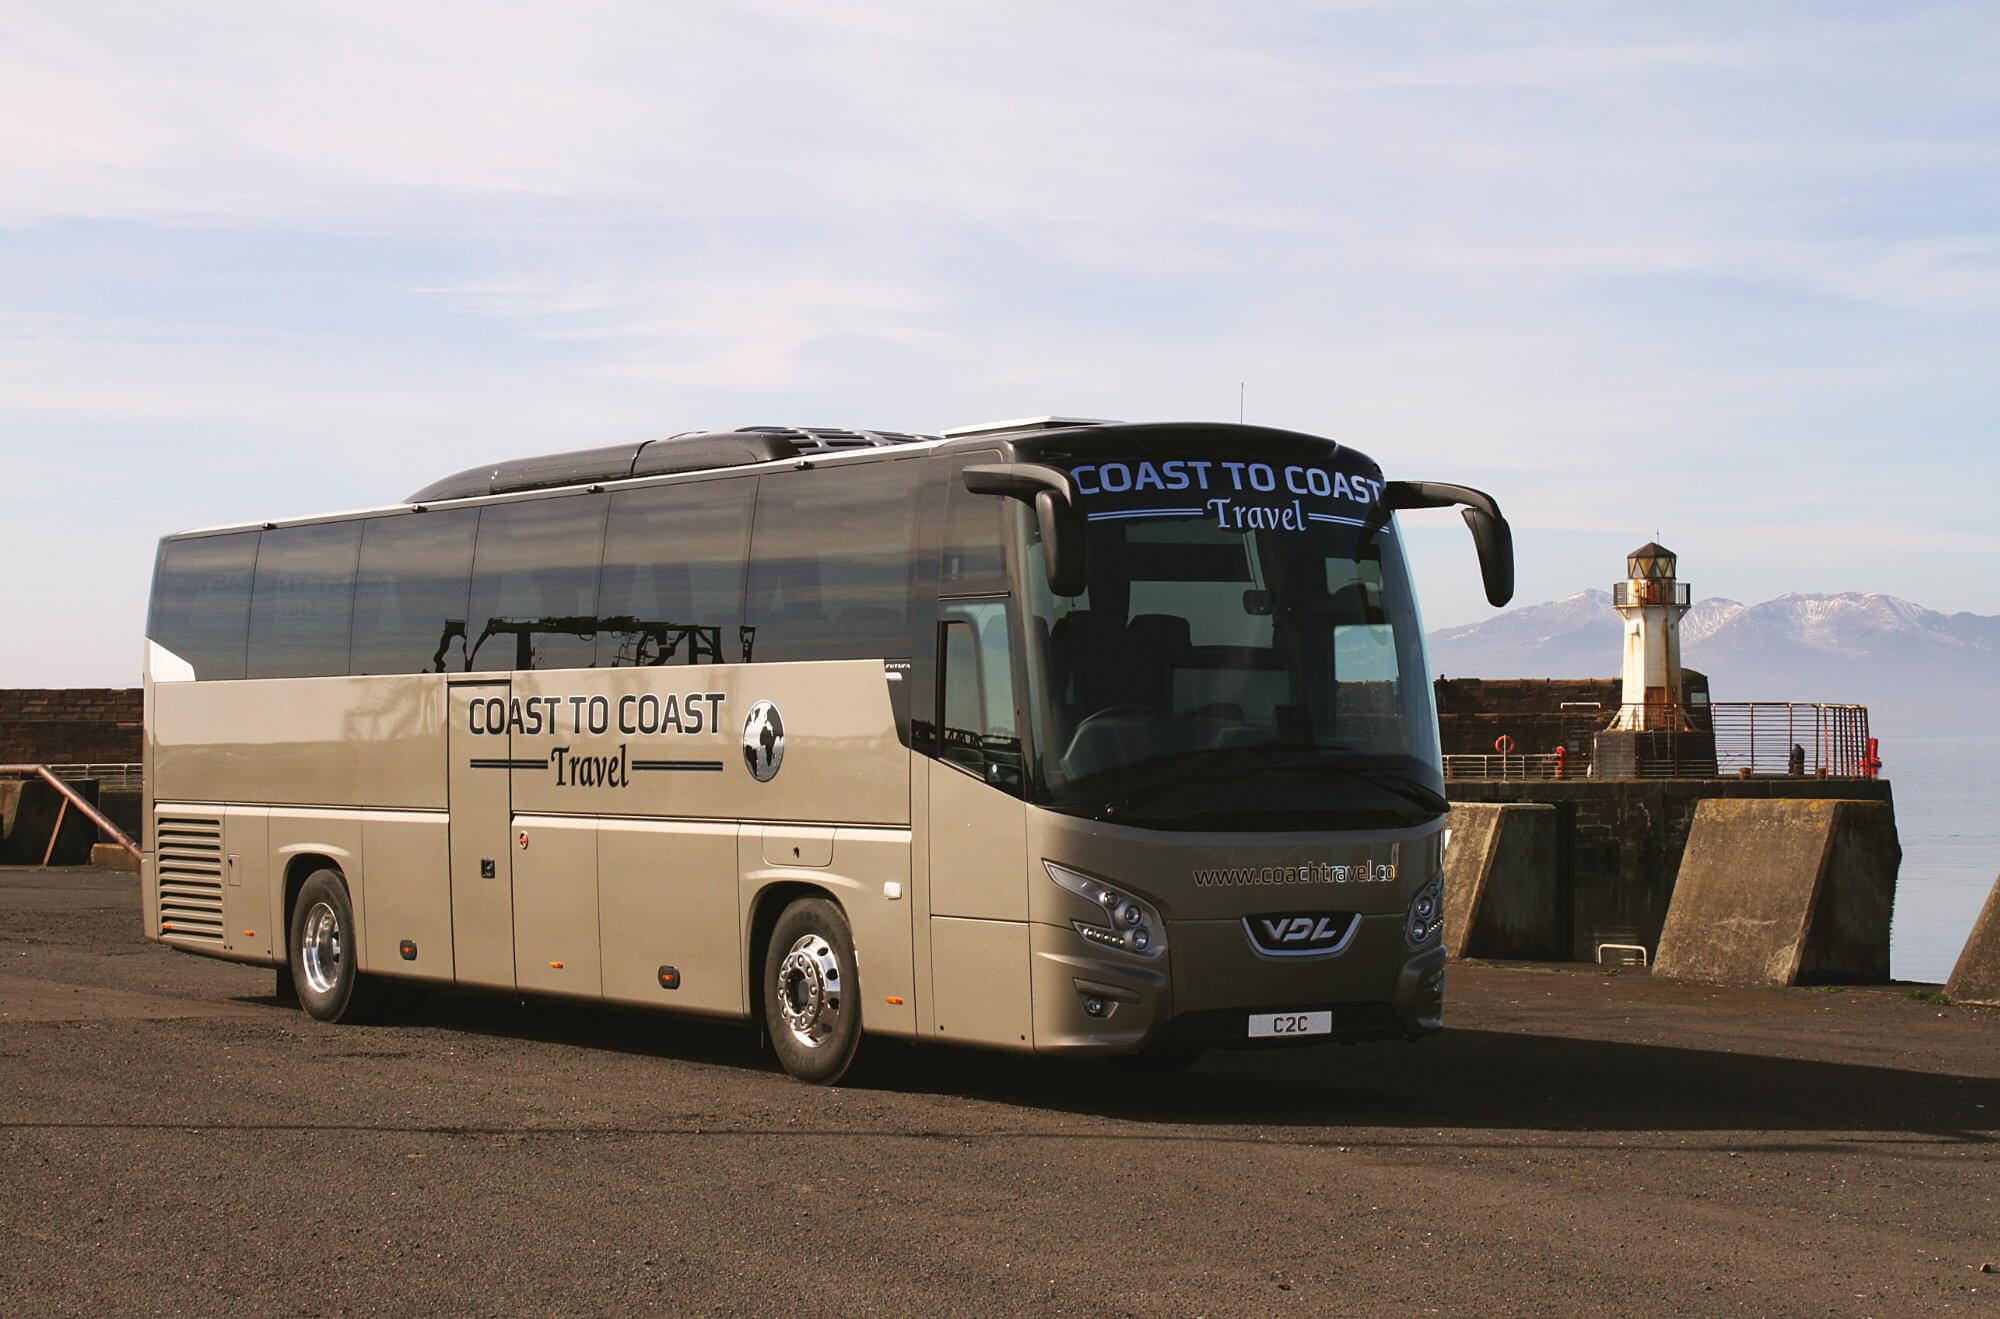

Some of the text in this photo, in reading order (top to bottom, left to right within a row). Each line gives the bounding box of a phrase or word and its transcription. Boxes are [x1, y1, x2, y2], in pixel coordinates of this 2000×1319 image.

[1070, 461, 1382, 504] COAST TO COAST
[1206, 498, 1307, 531] Travel
[469, 693, 726, 735] COAST TO COAST
[551, 743, 630, 788] Travel
[1261, 917, 1337, 942] VDL
[1273, 1016, 1308, 1033] C2C
